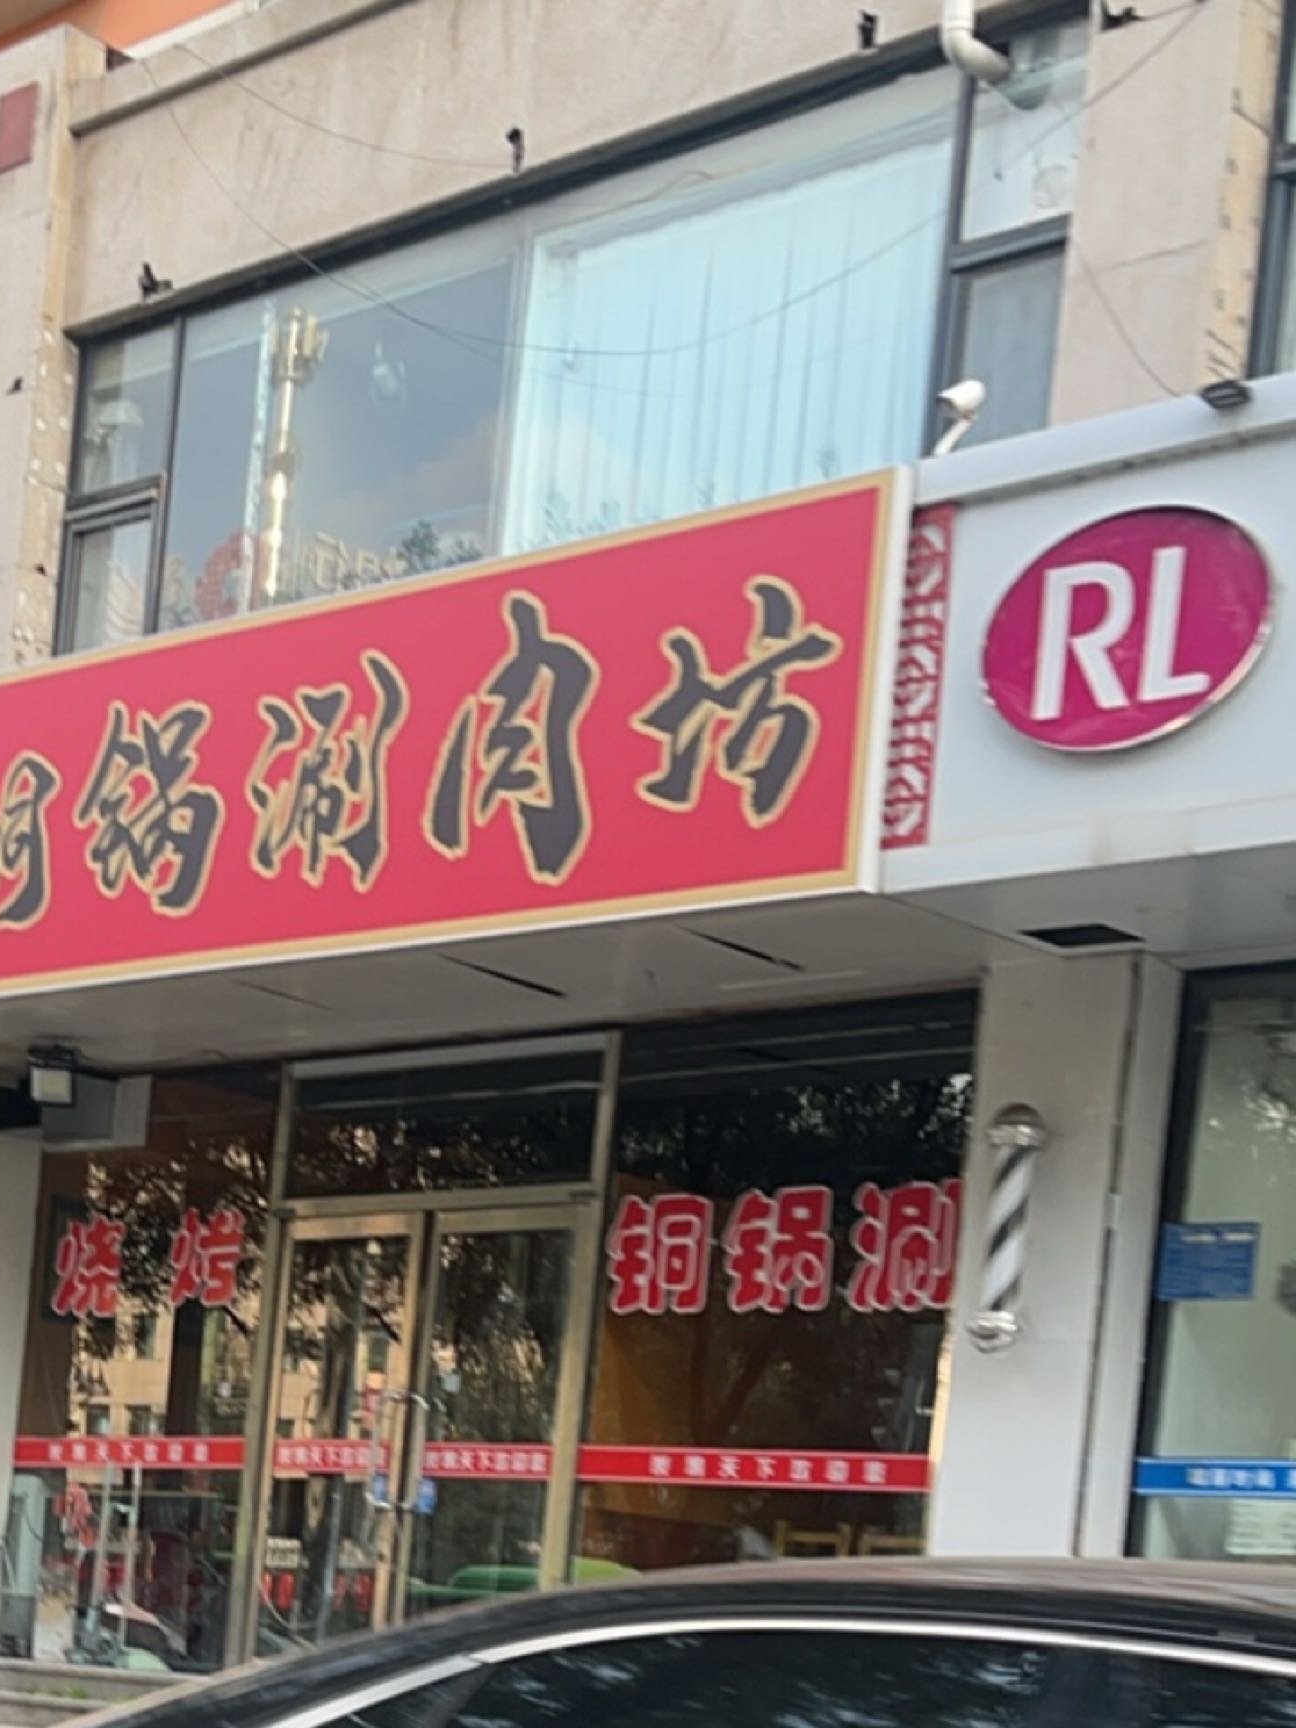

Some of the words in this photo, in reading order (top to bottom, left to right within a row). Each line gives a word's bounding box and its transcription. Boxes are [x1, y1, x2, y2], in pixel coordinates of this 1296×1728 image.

[1029, 544, 1210, 722] RL
[51, 1207, 246, 1318] 烧烤
[607, 1178, 962, 1316] 铜锅涮
